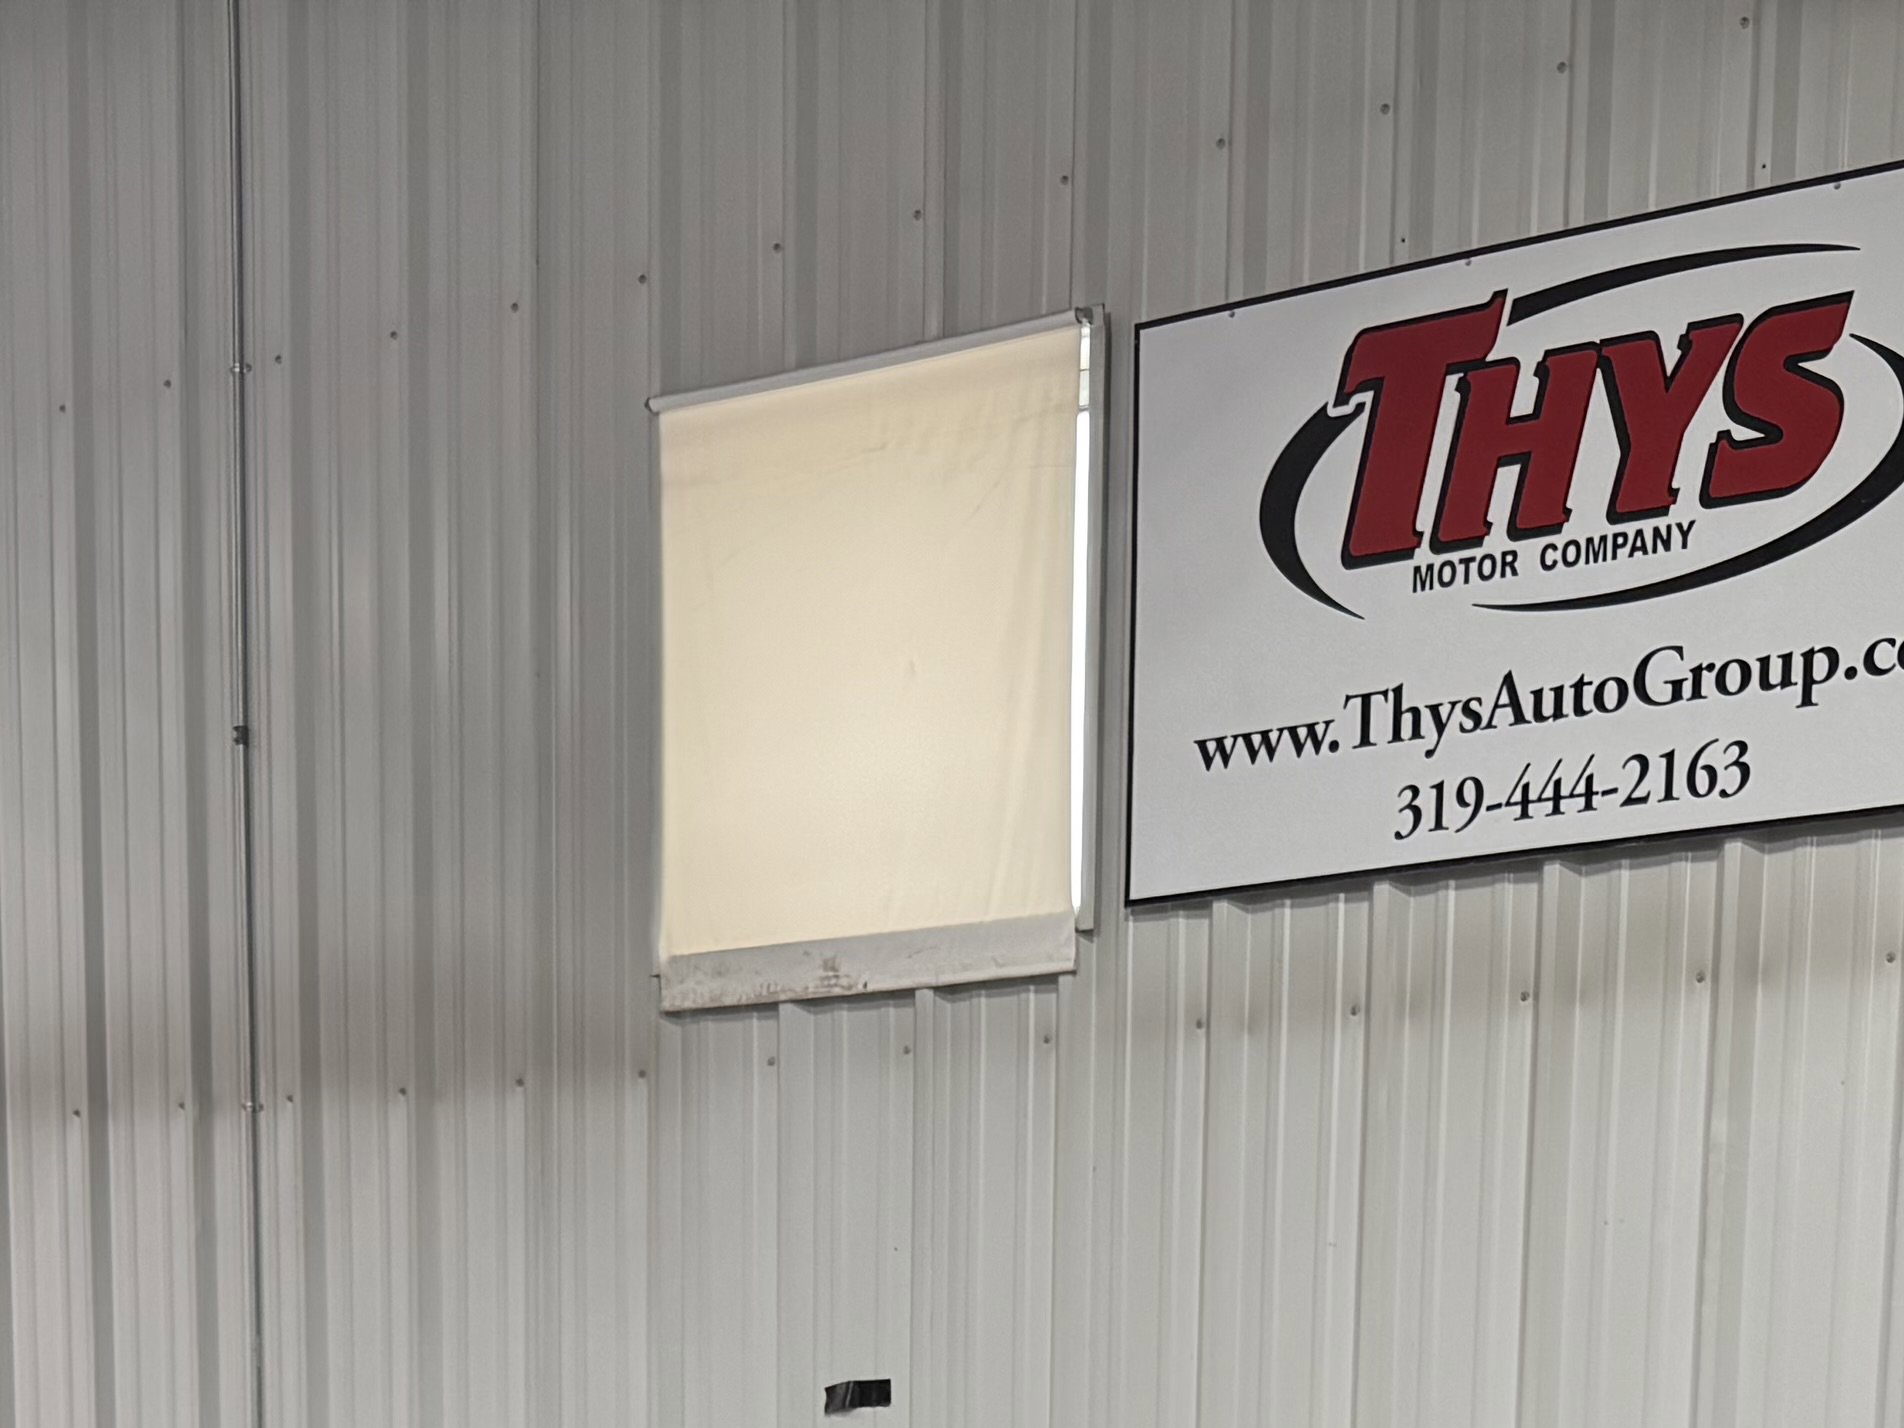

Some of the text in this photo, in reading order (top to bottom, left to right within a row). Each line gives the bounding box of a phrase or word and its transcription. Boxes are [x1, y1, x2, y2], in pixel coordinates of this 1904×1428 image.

[1331, 288, 1854, 570] THYS
[1411, 520, 1696, 594] MOTOR COMPANY
[1394, 739, 1752, 841] 319-444-2163
